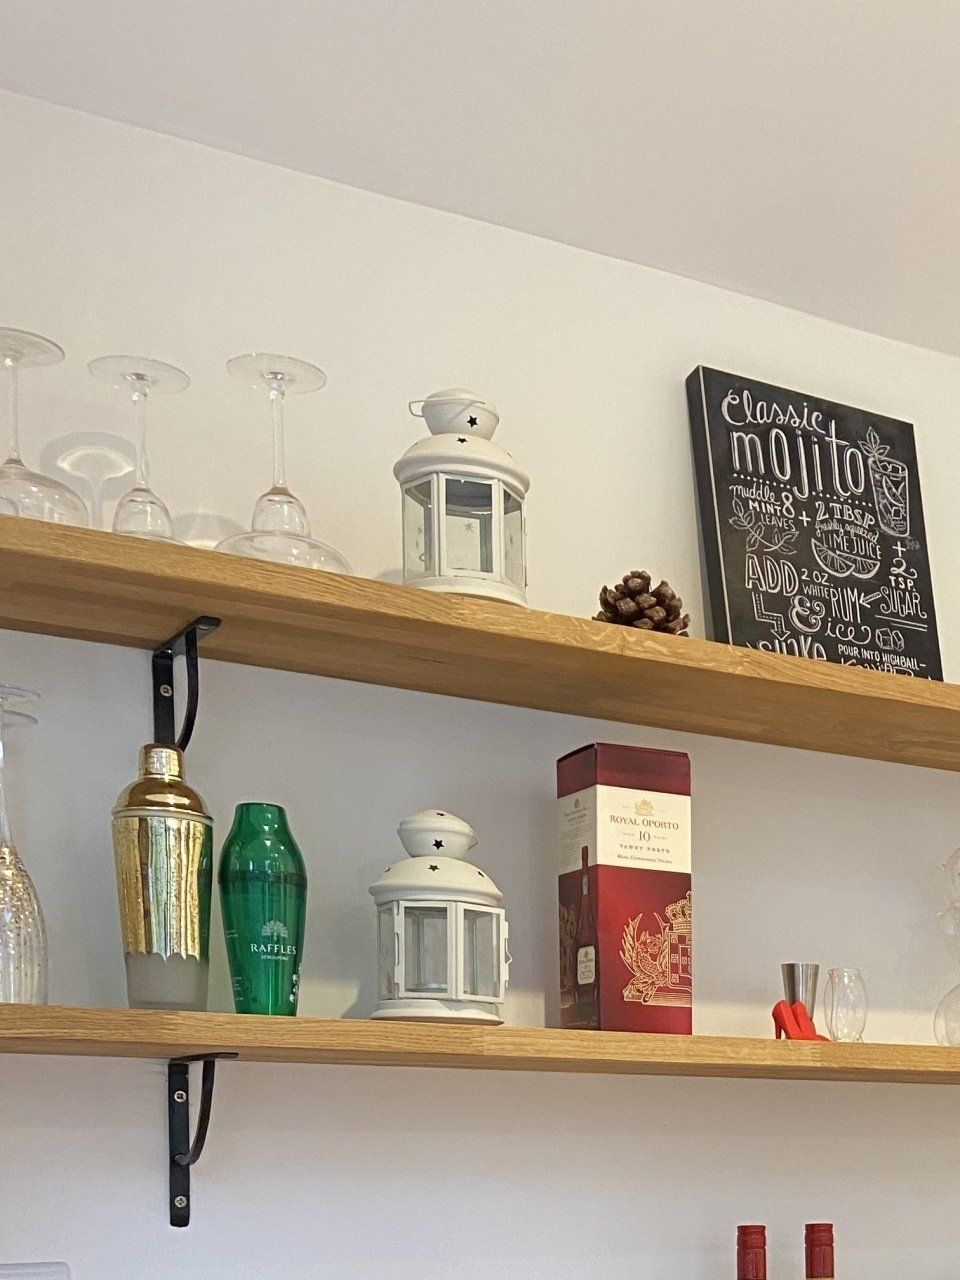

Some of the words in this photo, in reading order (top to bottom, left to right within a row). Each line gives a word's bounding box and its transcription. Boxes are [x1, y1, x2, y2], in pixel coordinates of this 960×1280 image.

[721, 389, 826, 434] Classic
[731, 419, 865, 500] mojito
[729, 483, 780, 505] muddle
[781, 491, 795, 518] 8
[749, 500, 781, 516] MINT
[815, 500, 829, 521] 2
[829, 502, 876, 530] TBSP
[760, 513, 796, 532] LEAVES
[822, 532, 849, 552] LIME
[852, 536, 882, 560] JUICE
[745, 553, 800, 597] ADD
[800, 568, 811, 581] 2
[812, 571, 834, 588] OZ.
[890, 557, 918, 579] 2
[801, 582, 830, 600] WHITE
[829, 586, 862, 624] RUM
[879, 585, 928, 619] SUGAR
[787, 595, 826, 635] &
[824, 618, 872, 645] ice
[837, 643, 861, 660] POUR
[861, 648, 880, 663] INTO
[609, 814, 640, 827] ROYAL
[641, 818, 680, 831] OPORTO
[639, 830, 651, 842] 10
[250, 943, 297, 955] RAFFLES
